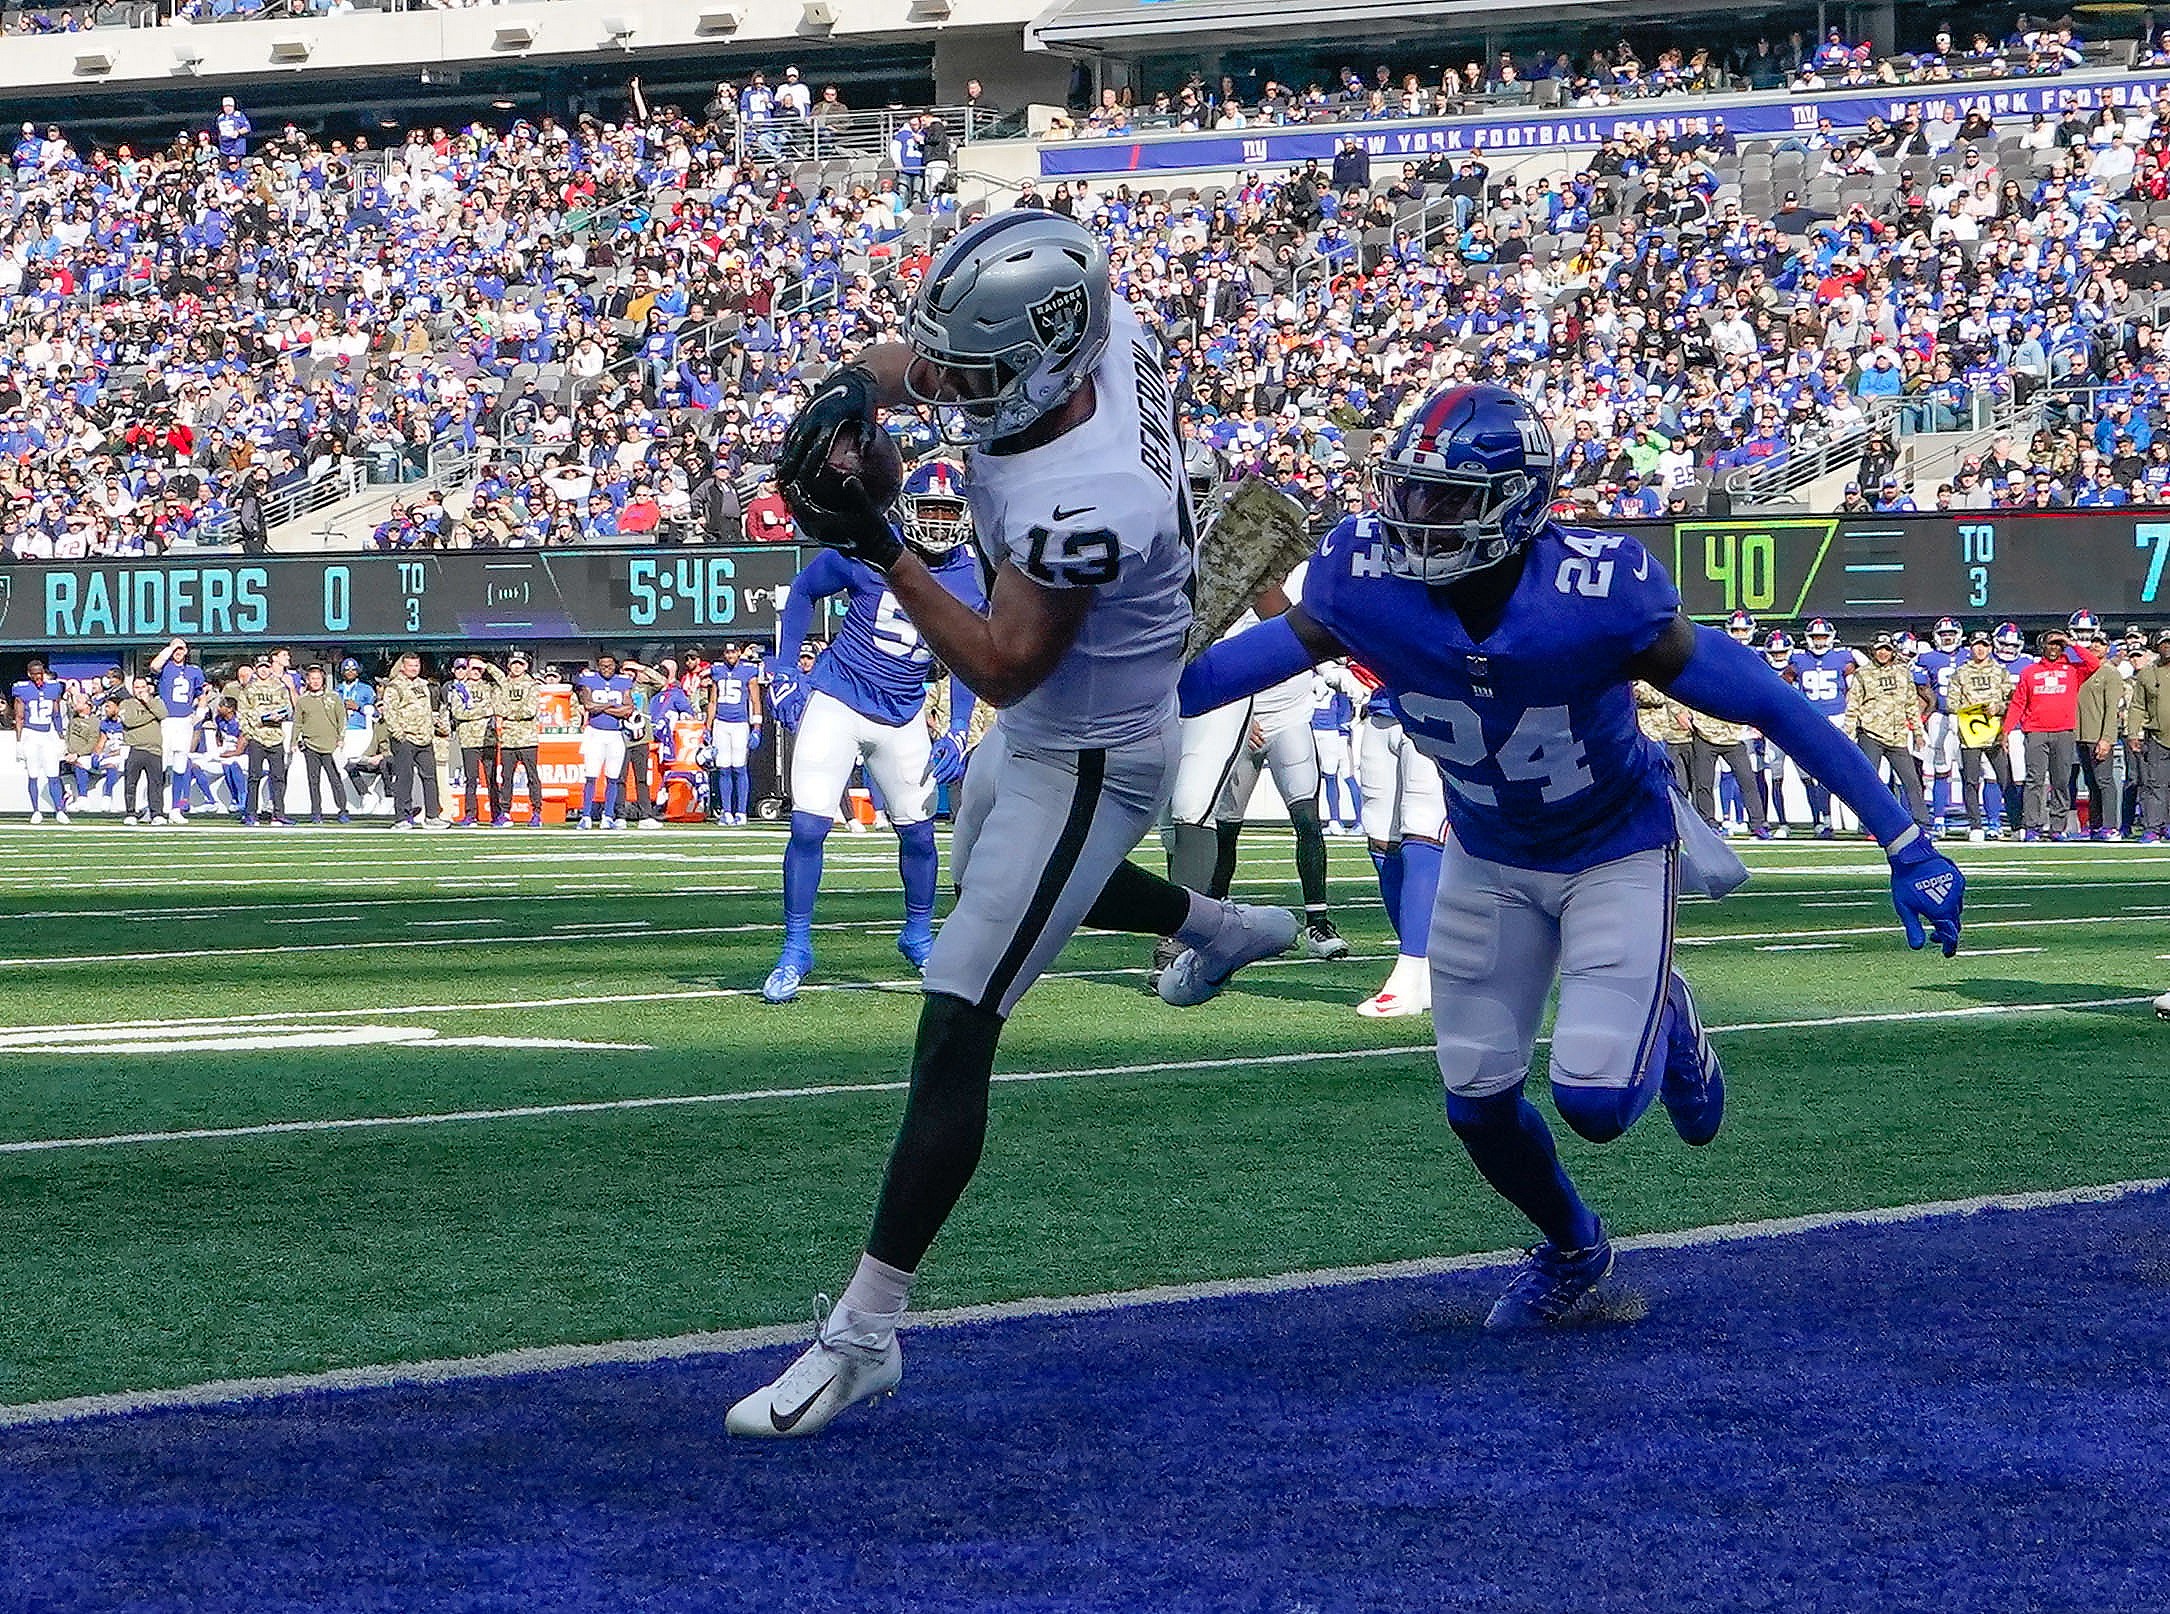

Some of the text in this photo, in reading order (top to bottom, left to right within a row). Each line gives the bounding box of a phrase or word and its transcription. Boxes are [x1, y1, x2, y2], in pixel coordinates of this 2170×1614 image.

[1890, 99, 1946, 121] NW
[1959, 92, 2028, 115] YORK
[1398, 130, 1462, 152] YORK
[1474, 122, 1600, 148] FOOTBALL
[1036, 289, 1082, 315] RAIDERS
[1027, 523, 1120, 585] 13
[1958, 525, 1995, 563] TO
[398, 562, 425, 594] TO
[1554, 531, 1624, 598] 24
[1705, 534, 1776, 610] 40
[2136, 523, 2170, 602] 7
[46, 566, 350, 637] RAIDERS 0
[629, 558, 736, 626] 5:46
[1969, 567, 1988, 607] 3
[406, 599, 420, 632] 3
[171, 676, 190, 703] 2
[717, 678, 742, 705] 15
[1802, 670, 1838, 701] 95
[28, 701, 53, 725] 12
[1398, 691, 1594, 807] 24
